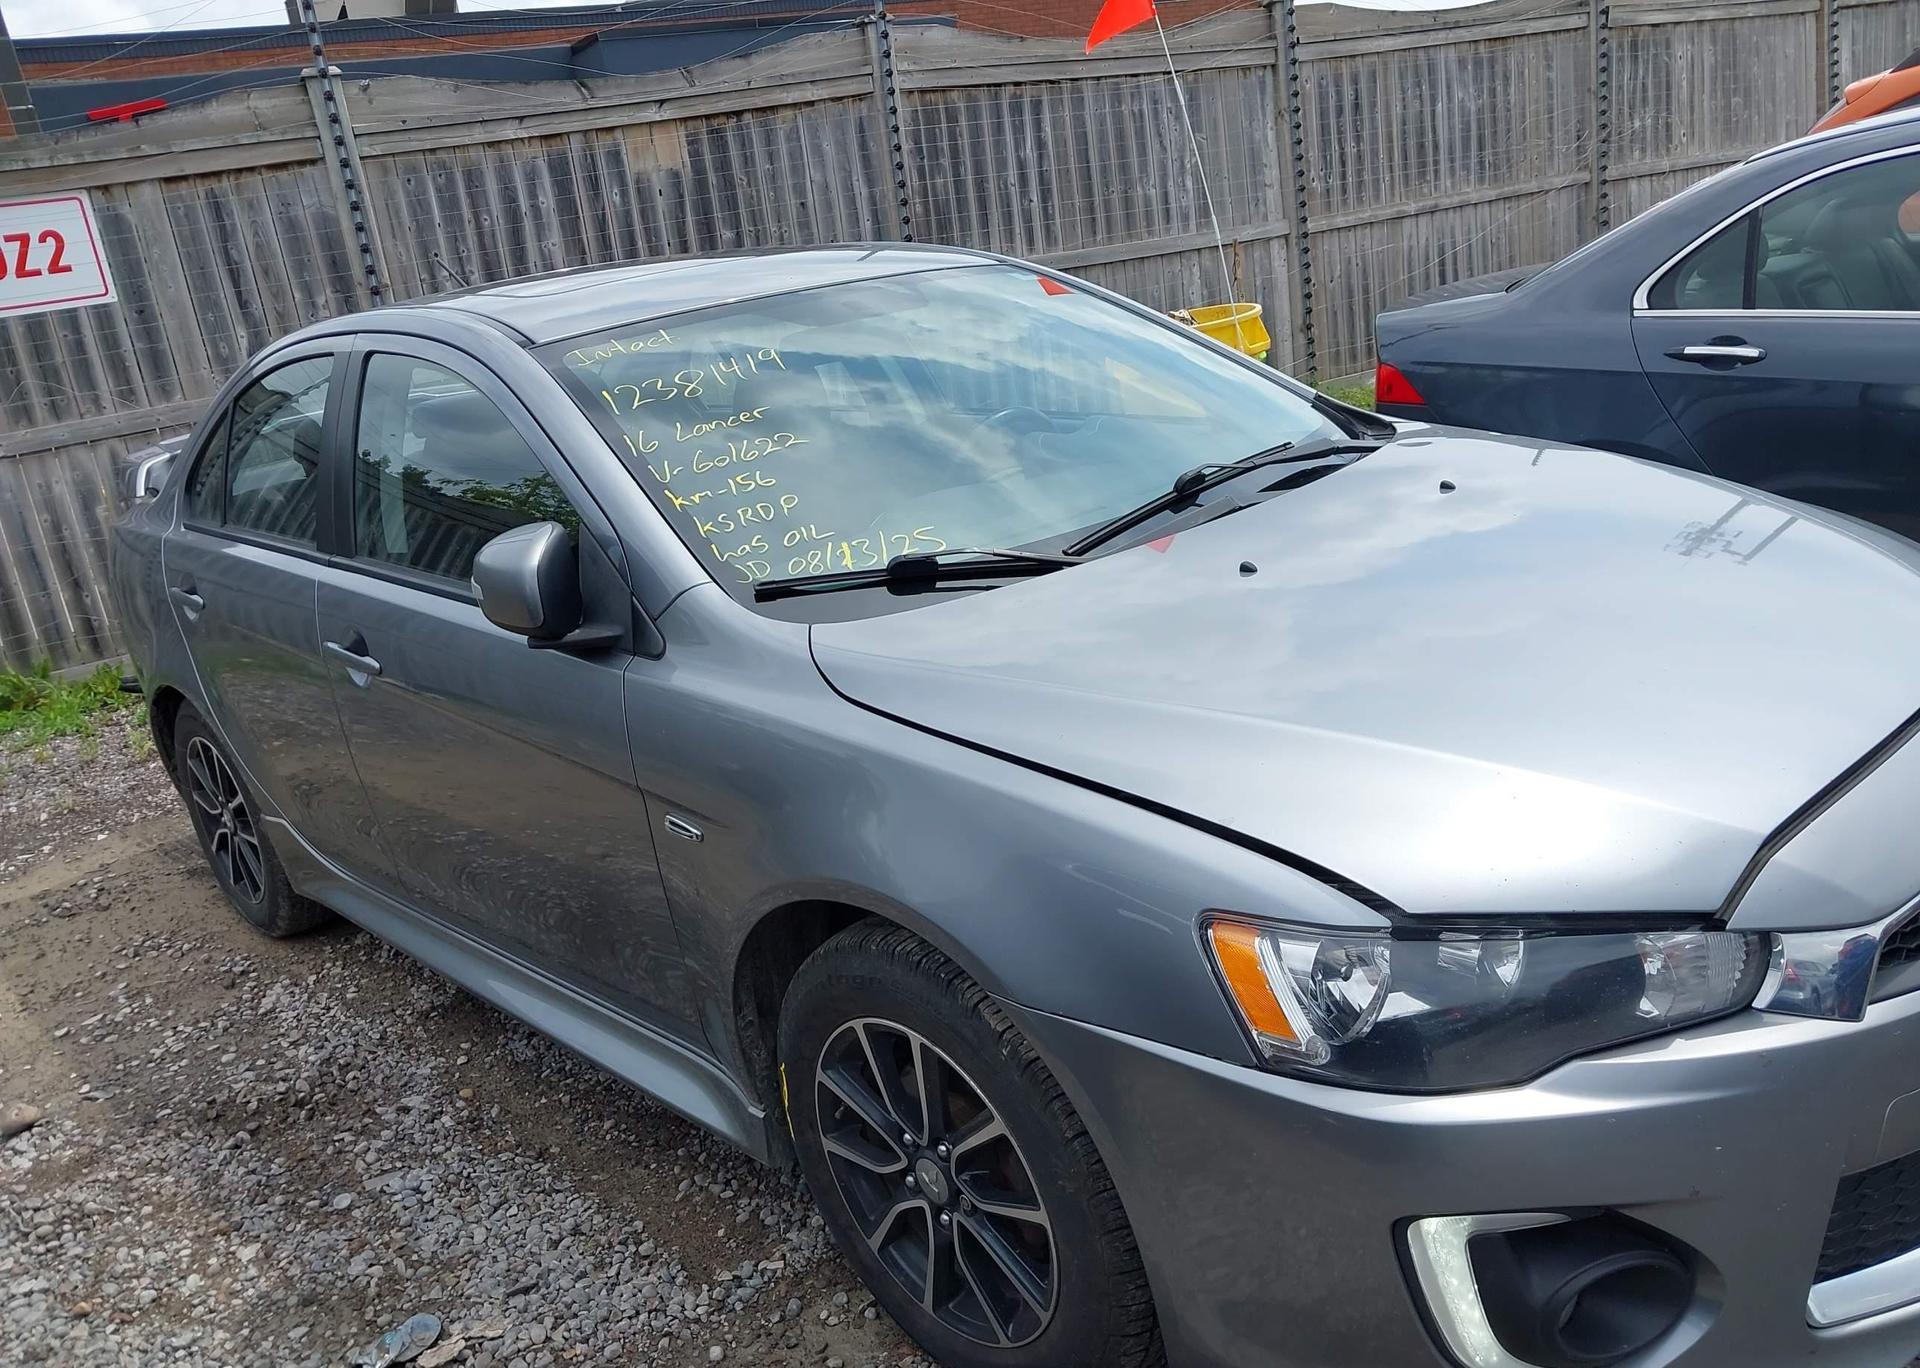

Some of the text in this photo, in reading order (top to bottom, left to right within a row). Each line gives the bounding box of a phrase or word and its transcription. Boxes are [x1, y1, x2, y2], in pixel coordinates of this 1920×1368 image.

[601, 347, 787, 416] 12381419
[623, 406, 771, 457] 16 Lancer
[710, 535, 769, 562] has
[735, 560, 771, 584] JD
